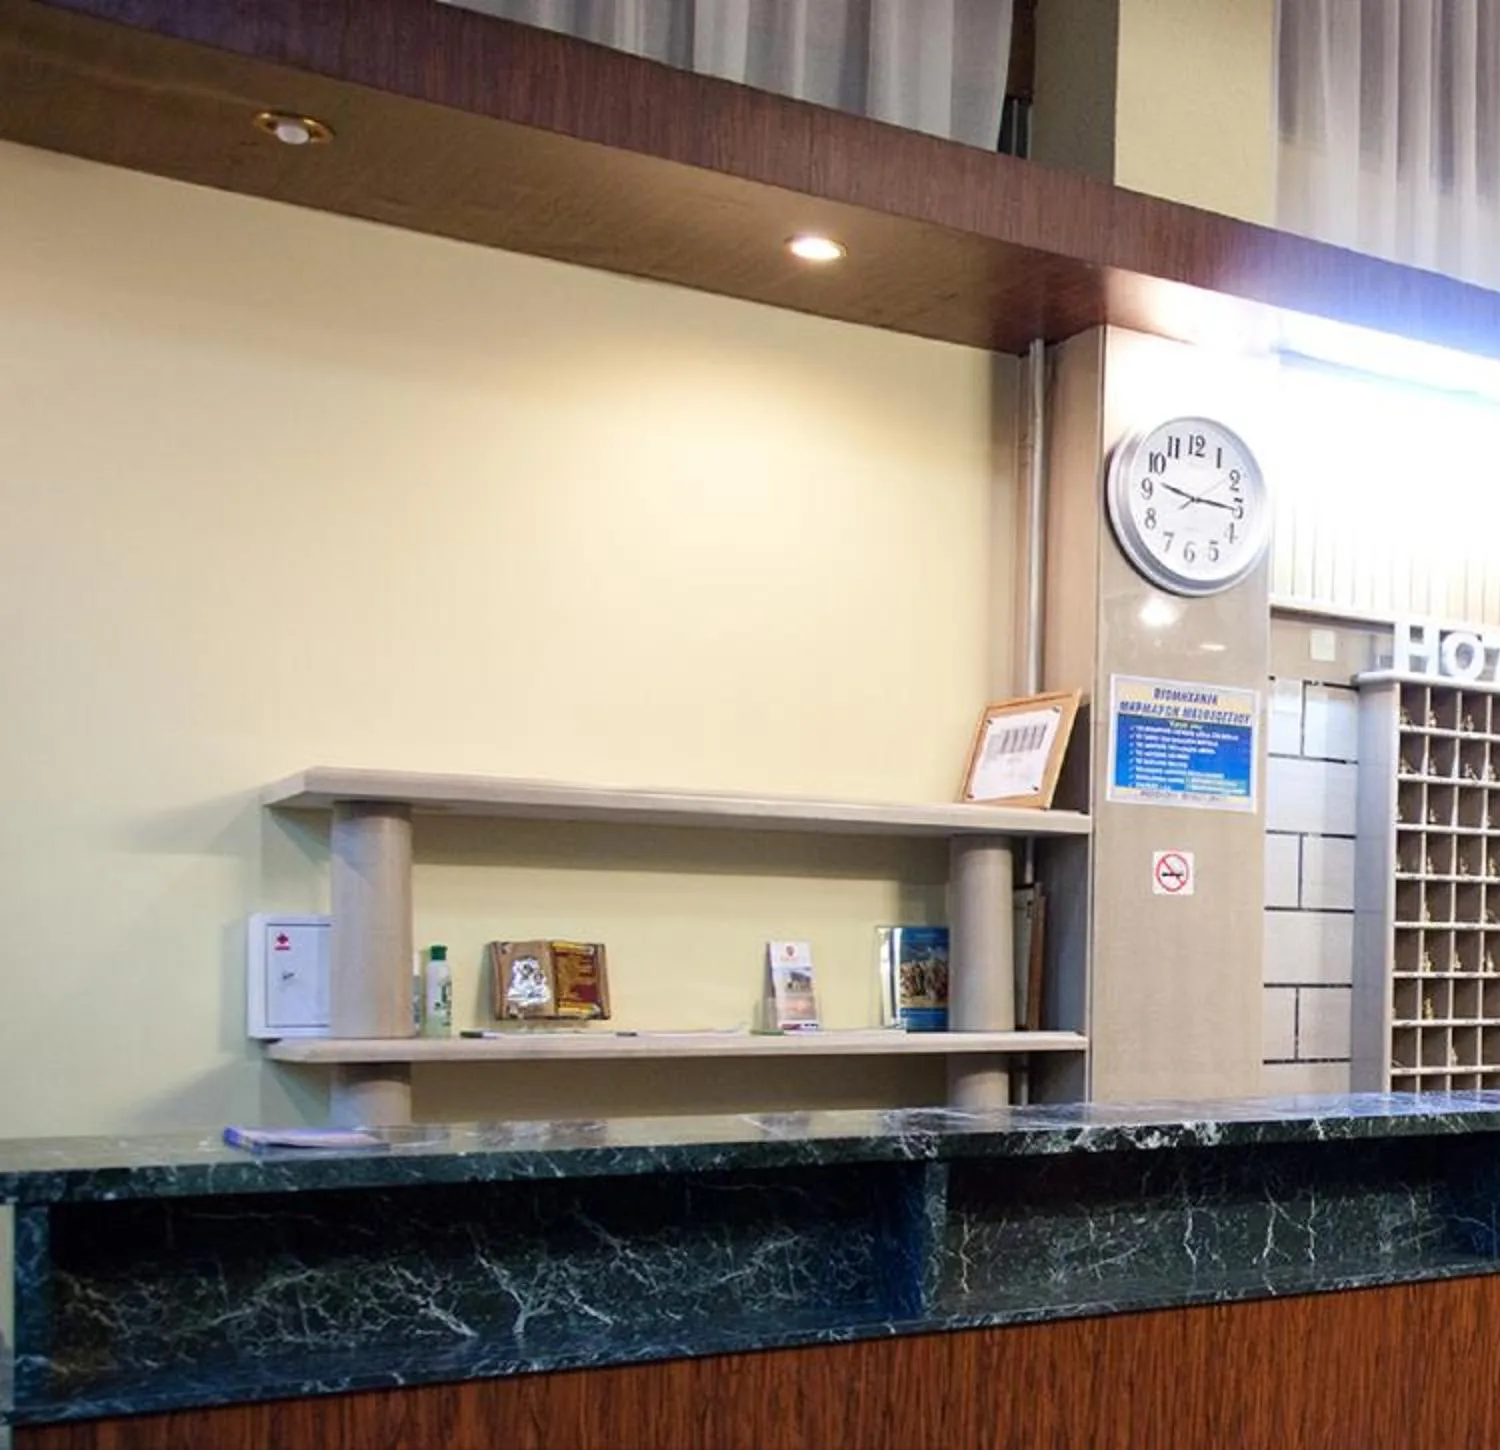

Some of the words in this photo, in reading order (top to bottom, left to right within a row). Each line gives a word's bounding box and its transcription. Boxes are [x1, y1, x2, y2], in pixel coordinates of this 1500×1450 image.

[1167, 436, 1181, 459] 11
[1187, 434, 1206, 457] 12
[1149, 451, 1167, 475] 10
[1216, 448, 1223, 469] 1
[1141, 478, 1153, 500] 9
[1229, 469, 1241, 492] 2
[1144, 508, 1157, 529] 8
[1232, 497, 1244, 520] 3
[1163, 531, 1175, 552] 7
[1225, 522, 1238, 544] 4
[1184, 542, 1195, 563] 6
[1208, 540, 1219, 562] 5
